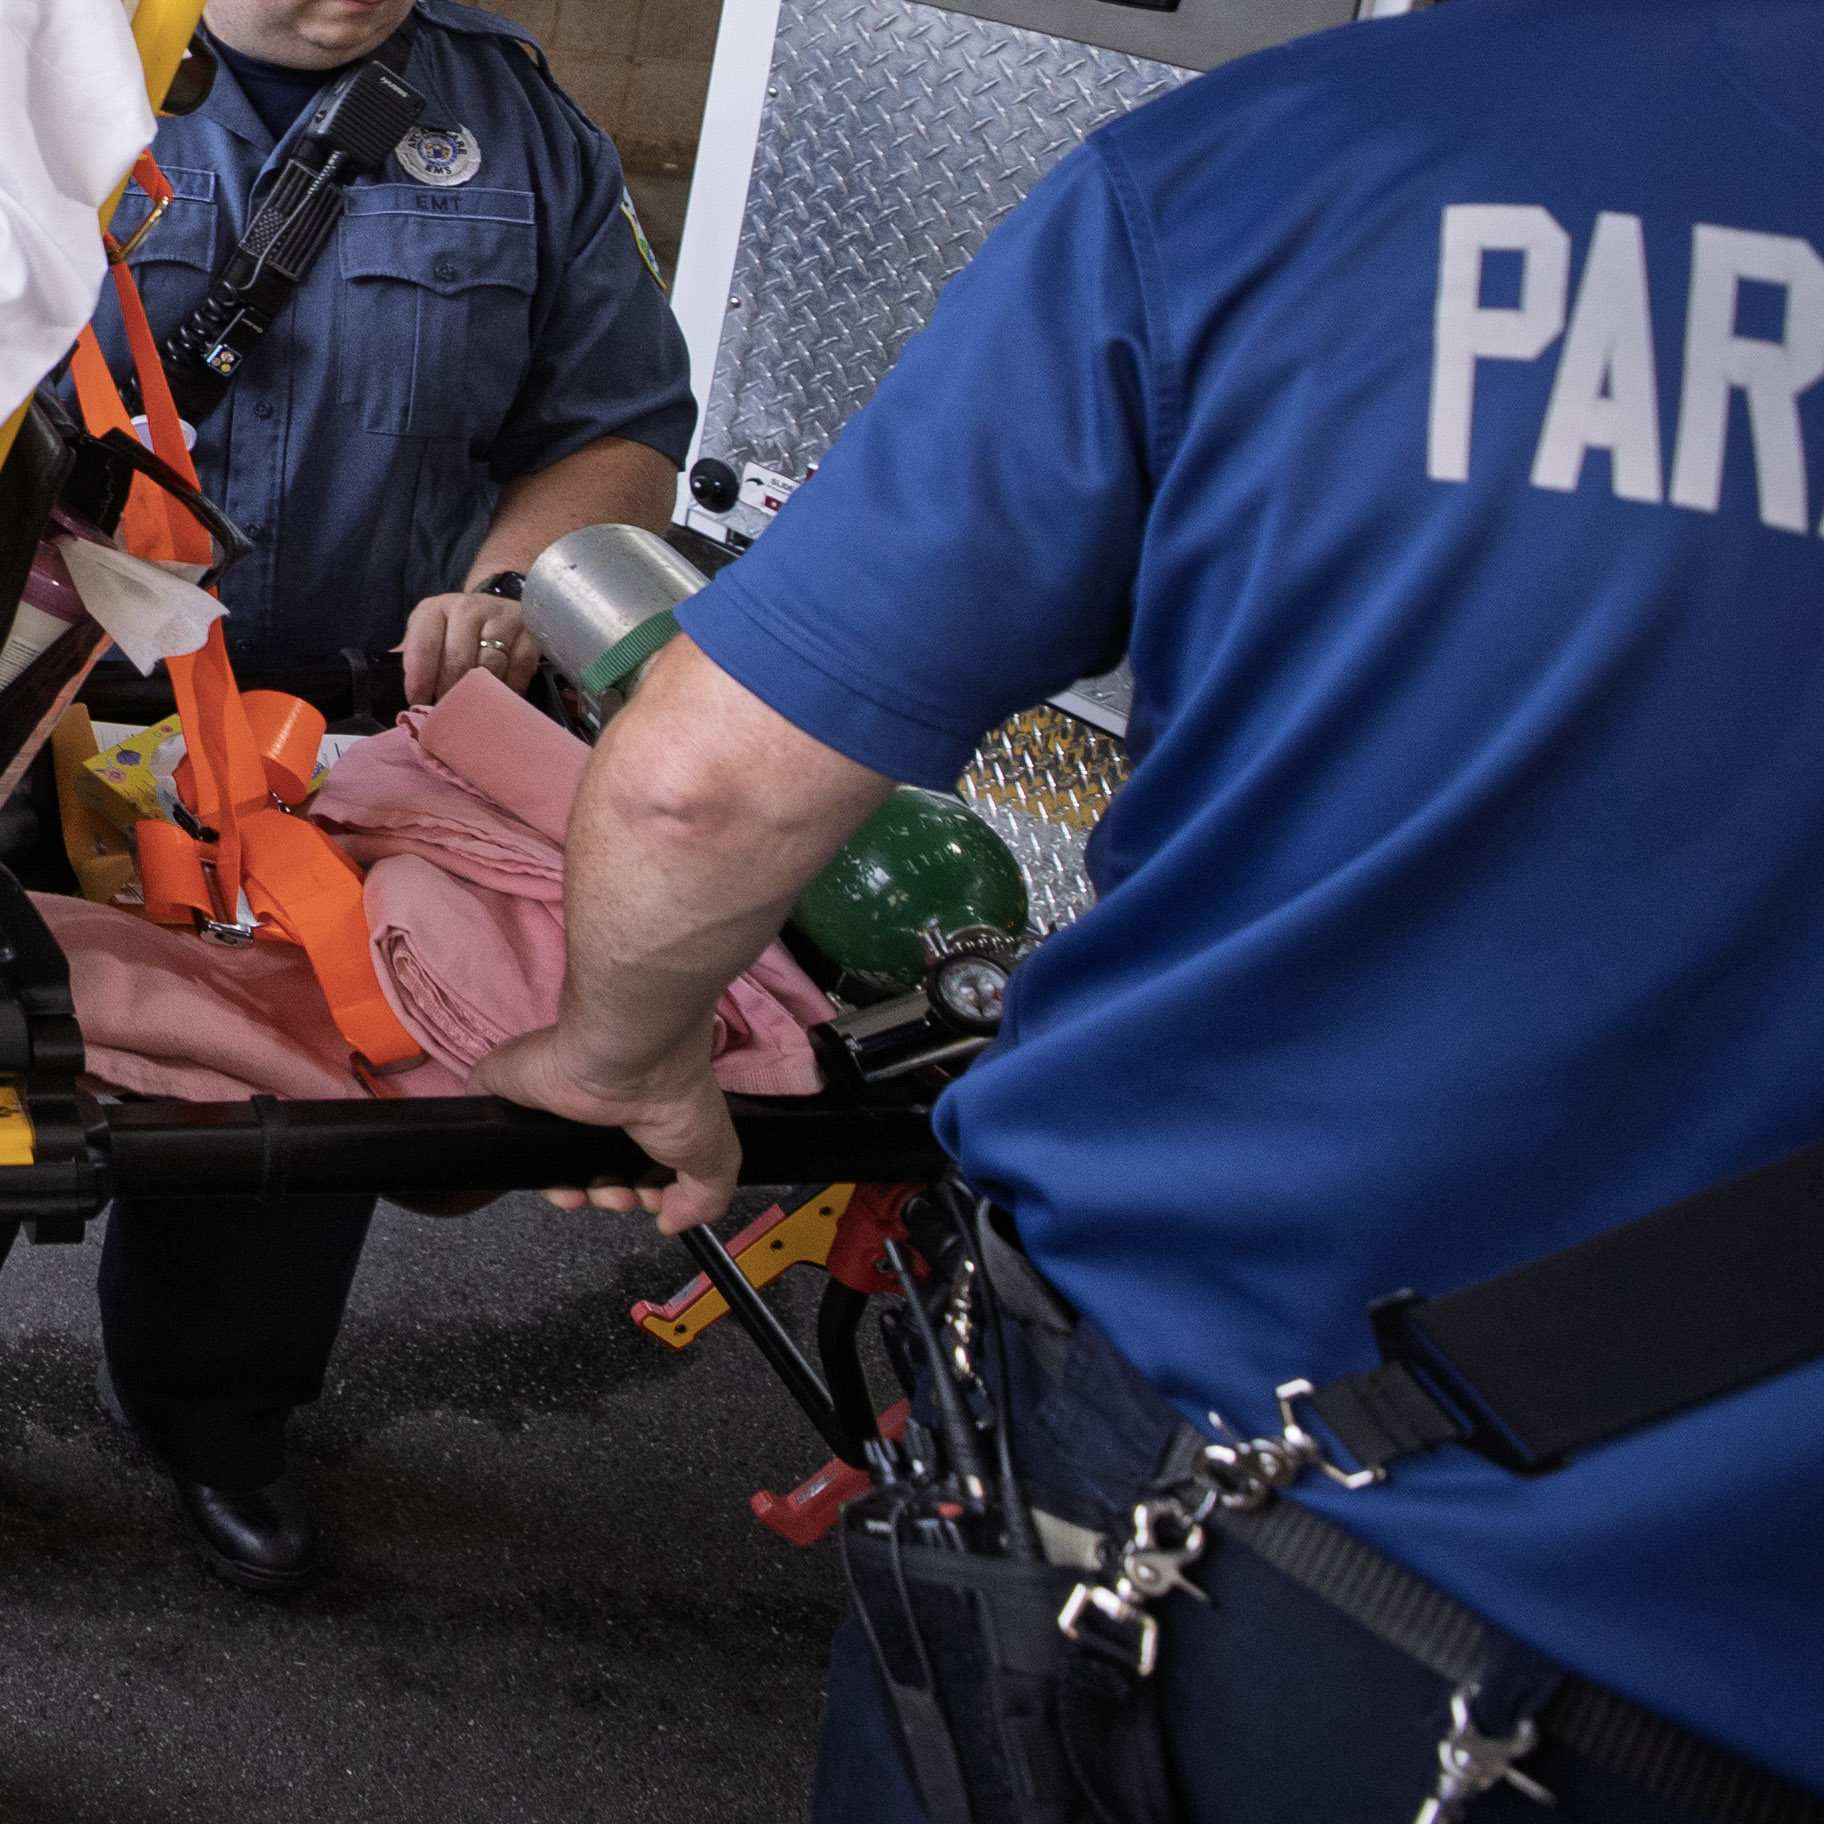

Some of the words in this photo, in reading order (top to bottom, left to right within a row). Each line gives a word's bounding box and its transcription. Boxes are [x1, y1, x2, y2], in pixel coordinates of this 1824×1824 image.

[425, 164, 452, 174] EMS
[416, 195, 463, 212] EMT
[1427, 203, 1824, 540] PAR
